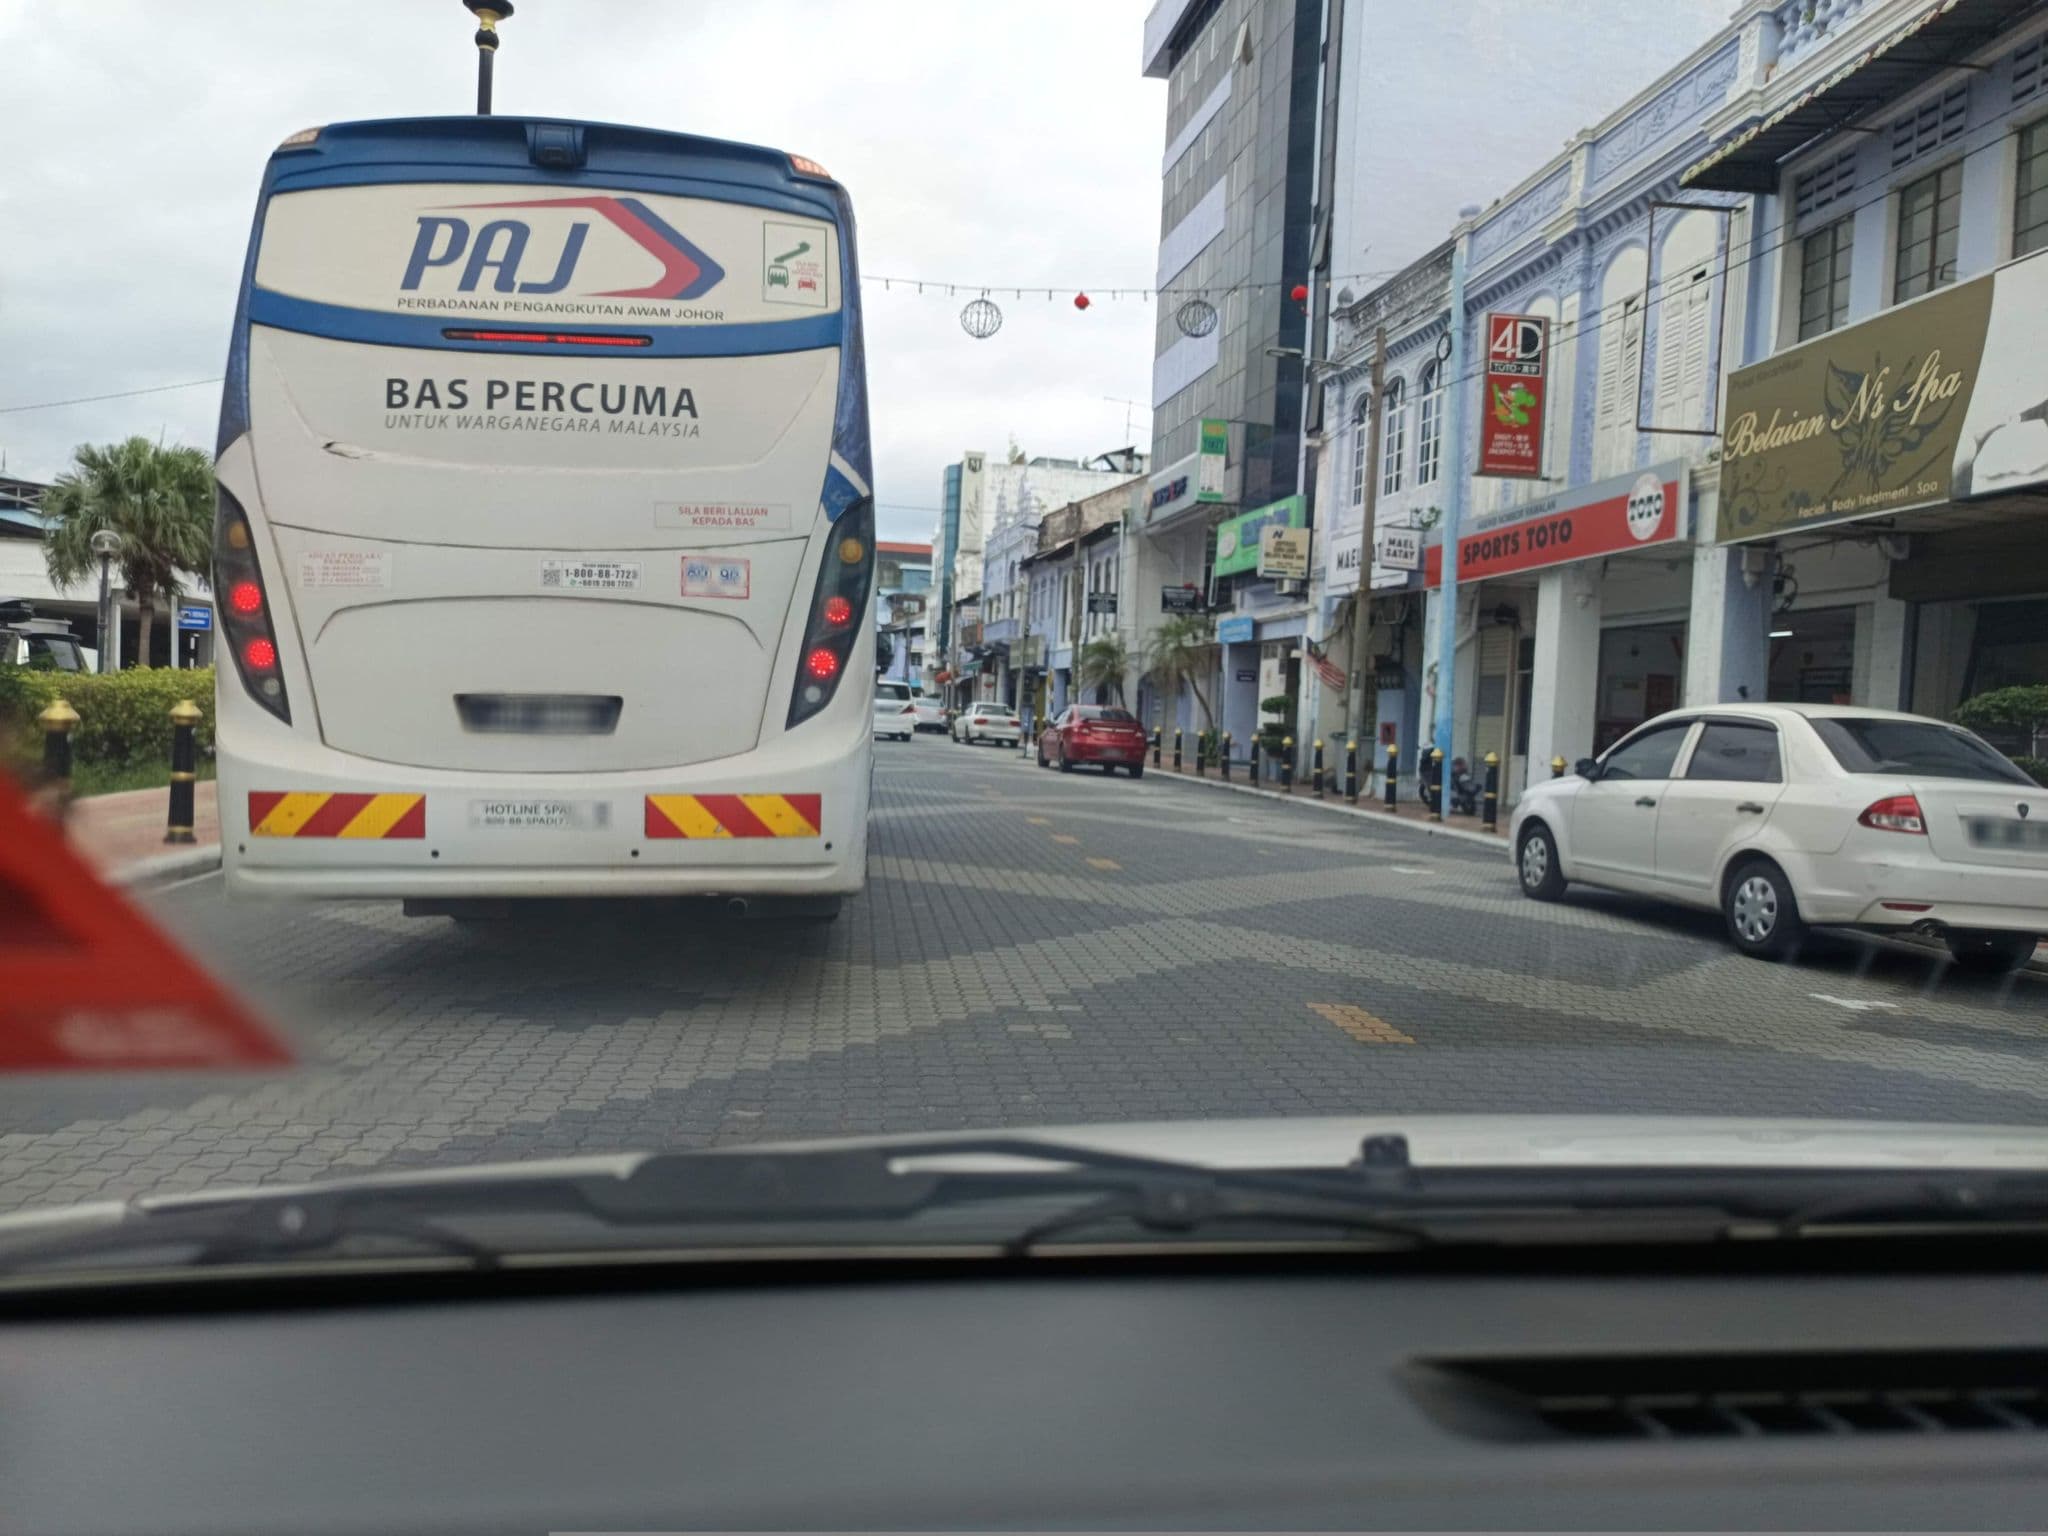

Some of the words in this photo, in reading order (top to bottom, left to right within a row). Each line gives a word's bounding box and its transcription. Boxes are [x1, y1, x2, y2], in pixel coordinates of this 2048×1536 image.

[400, 216, 590, 294] PAJ
[397, 297, 499, 311] PERBADANAN
[503, 301, 623, 315] PENGANGKUTAN
[627, 306, 671, 318] AWAM
[675, 308, 724, 320] JOHOR
[1491, 320, 1544, 359] 4D
[386, 378, 468, 409] BAS
[486, 380, 698, 418] PERCUMA
[1723, 408, 1825, 462] Belaian
[1893, 349, 1965, 429] Spa
[385, 414, 449, 429] UNTUK
[456, 415, 600, 433] WARGANEGARA
[608, 419, 700, 438] MALAYSIA
[1858, 485, 1909, 505] Treatment
[1917, 480, 1938, 496] Spa
[678, 506, 701, 516] SILA
[703, 507, 726, 516] BERI
[728, 507, 768, 517] LALUAN
[1629, 492, 1663, 522] TOTO
[692, 517, 733, 526] KEPADA
[735, 518, 755, 527] BAS
[1388, 537, 1414, 550] MAEL
[1463, 529, 1520, 565] SPORTS
[1526, 518, 1573, 551] TOTO
[1385, 549, 1415, 561] SATAY
[485, 803, 541, 815] HOTLINE
